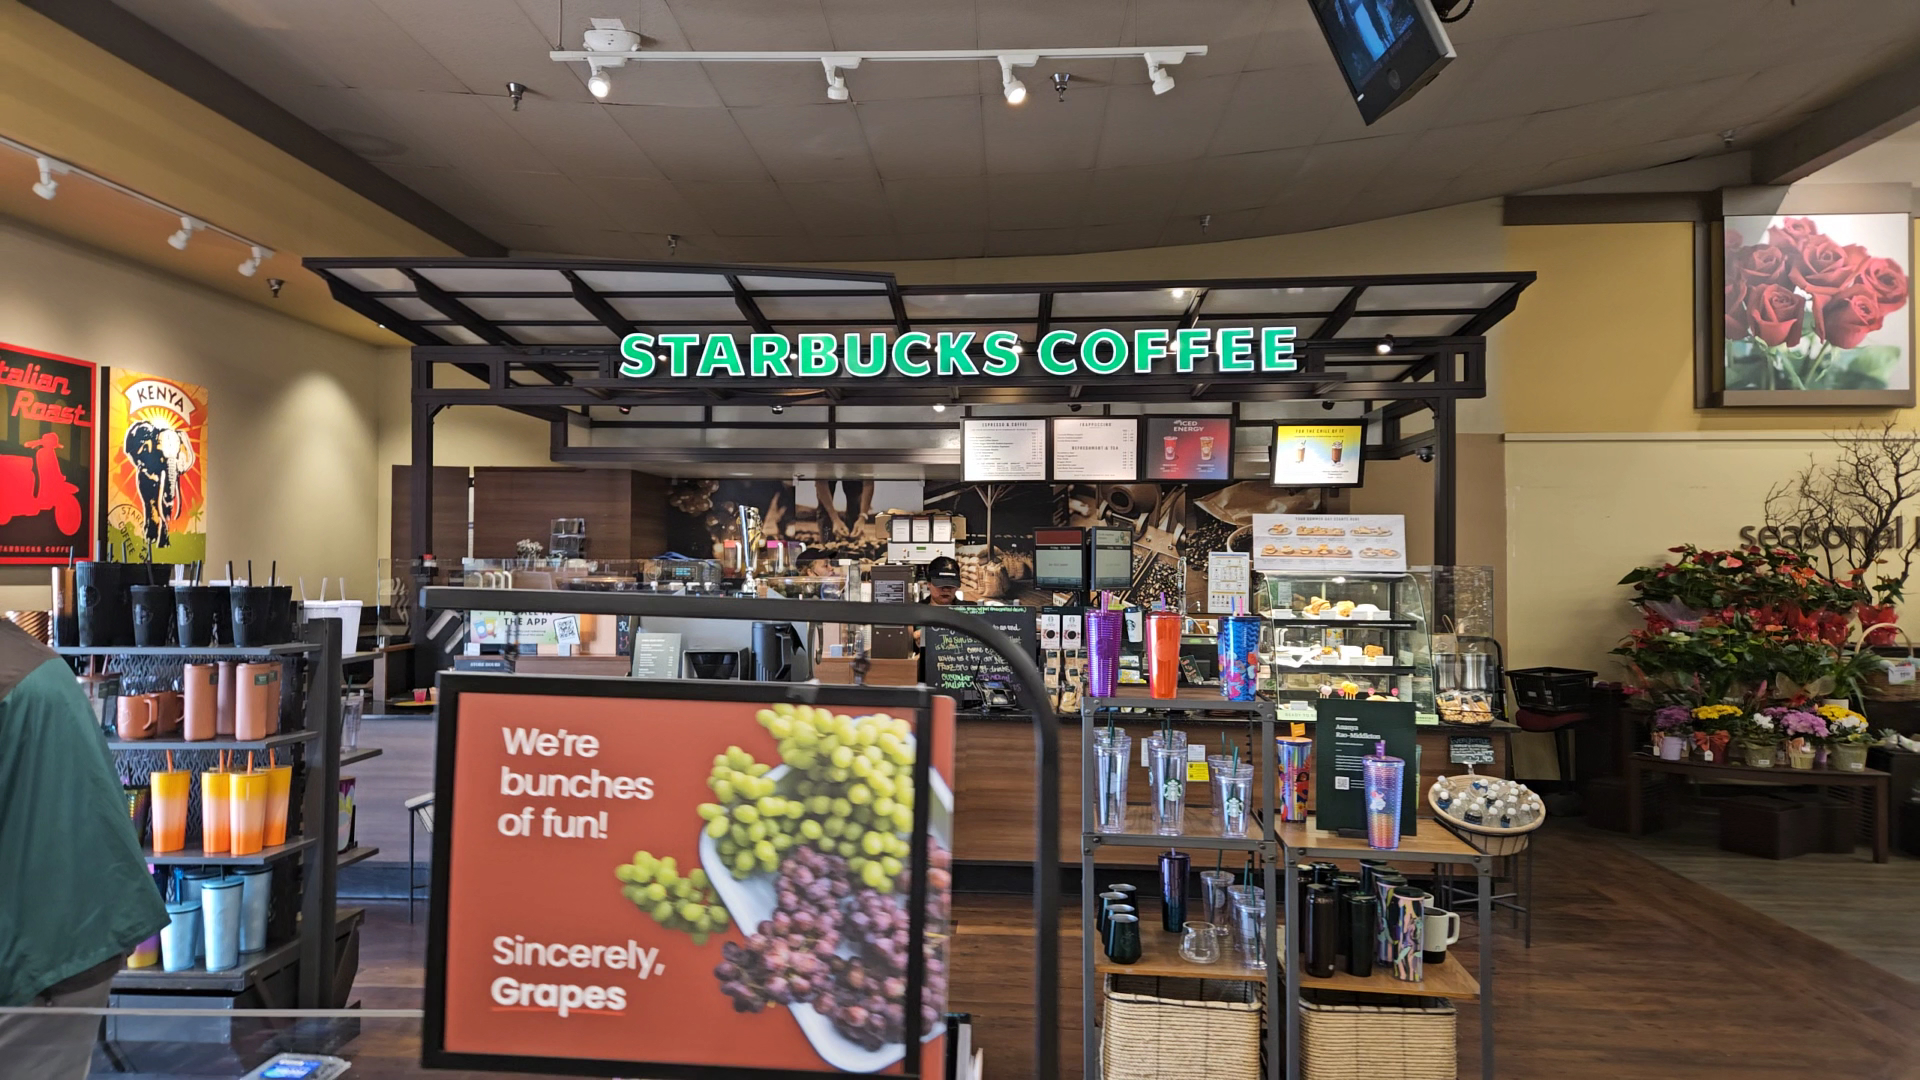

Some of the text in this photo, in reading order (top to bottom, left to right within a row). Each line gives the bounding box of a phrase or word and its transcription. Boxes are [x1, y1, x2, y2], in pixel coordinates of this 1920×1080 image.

[619, 326, 1298, 377] STARBUCKS COFFEE
[0, 361, 71, 395] talian
[11, 390, 90, 426] Roast
[136, 385, 184, 413] KENYA
[45, 545, 71, 553] COFFE
[1739, 515, 1903, 550] seasonal
[504, 618, 548, 626] THE APP
[502, 726, 600, 758] We're
[500, 766, 655, 800] bunches
[497, 806, 608, 839] of fun!
[492, 935, 666, 980] Sincerely,
[490, 976, 627, 1018] Grapes
